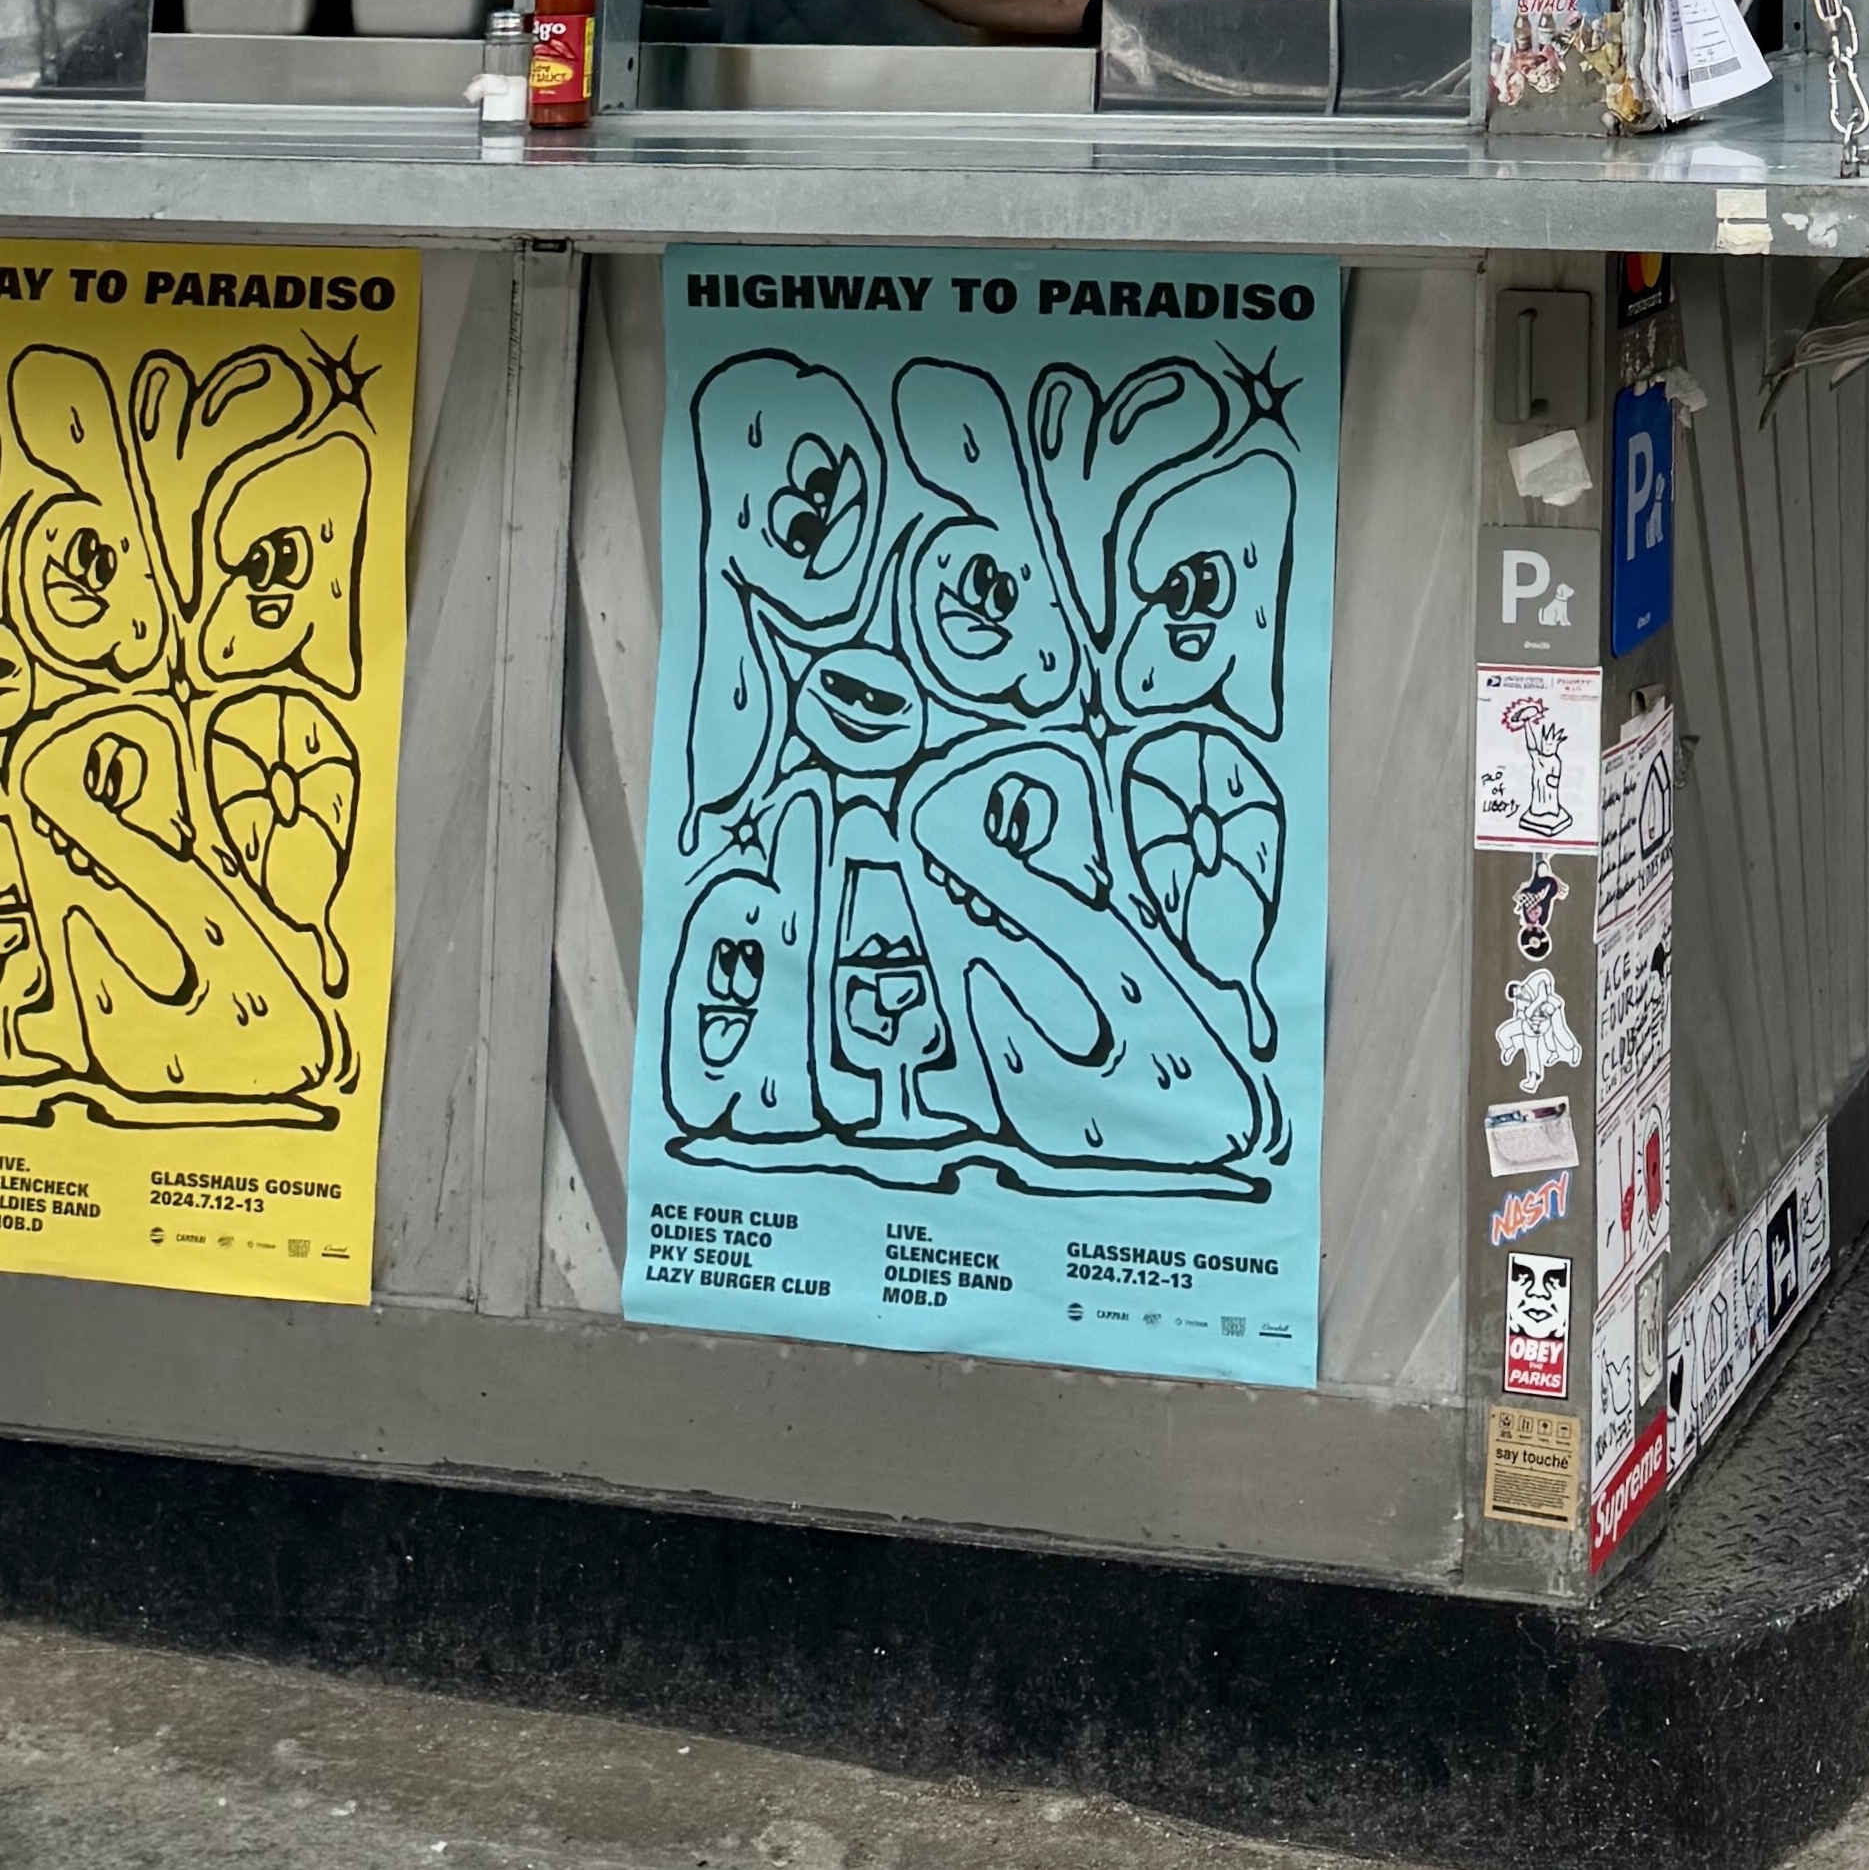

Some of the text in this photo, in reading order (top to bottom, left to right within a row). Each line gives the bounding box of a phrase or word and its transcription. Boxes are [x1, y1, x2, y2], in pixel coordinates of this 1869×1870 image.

[70, 268, 128, 304] TO
[144, 270, 396, 312] PARADISO
[686, 273, 1316, 322] HIGHWAY TO PARADISO
[1625, 430, 1655, 562] P
[1501, 549, 1551, 625] P
[1603, 950, 1631, 1001] ACE
[1600, 985, 1635, 1041] FOUR
[0, 1156, 31, 1173] IVE.
[150, 1170, 343, 1200] GLASSHAUS GOSUNG
[52, 1199, 102, 1219] BAND
[150, 1190, 265, 1214] 2024.7.12-13
[1491, 1170, 1570, 1246] NASTY
[0, 1215, 44, 1233] OB.D
[650, 1203, 799, 1230] ACE FOUR CLUB
[650, 1223, 773, 1248] OLDIES TACO
[886, 1223, 934, 1243] LIVE.
[649, 1243, 754, 1269] PKY SEOUL
[885, 1243, 1000, 1270] GLENCHECK
[1066, 1241, 1280, 1276] GLASSHAUS GOSUNG
[646, 1264, 832, 1297] LAZY BURGER CLUB
[884, 1264, 1014, 1292] OLDIES BAND
[1066, 1261, 1193, 1290] 2024.7.12-13
[882, 1286, 949, 1308] MOB.D
[1509, 1334, 1564, 1366] OBEY
[1508, 1368, 1562, 1391] PARKS
[1495, 1448, 1520, 1465] say
[1594, 1433, 1663, 1549] Supreme
